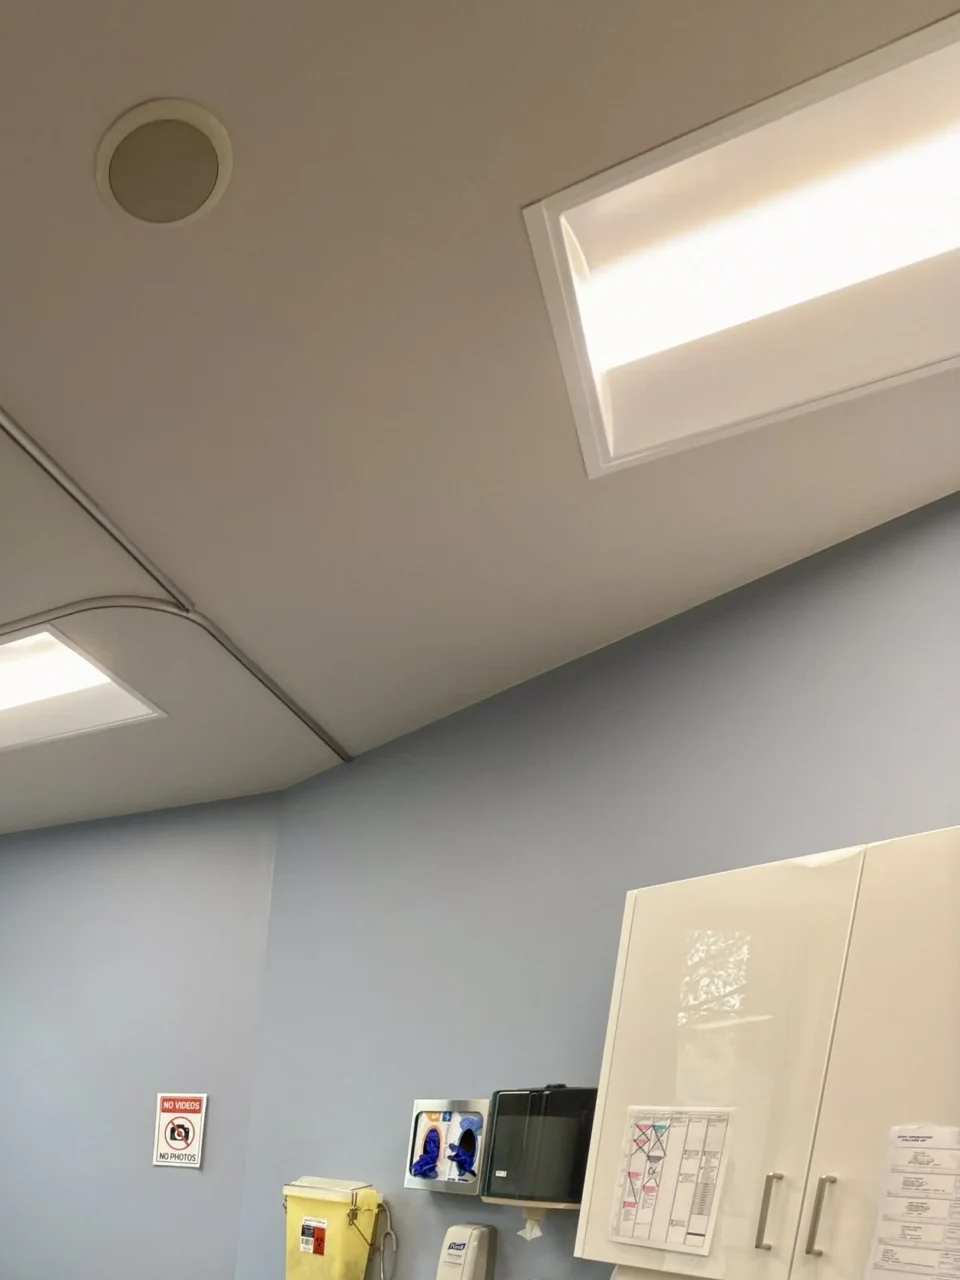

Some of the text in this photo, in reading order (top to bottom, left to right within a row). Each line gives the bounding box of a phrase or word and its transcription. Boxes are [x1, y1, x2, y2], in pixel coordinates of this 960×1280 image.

[164, 1101, 200, 1110] NO VIDEOS
[159, 1152, 196, 1162] NO PHOTOS
